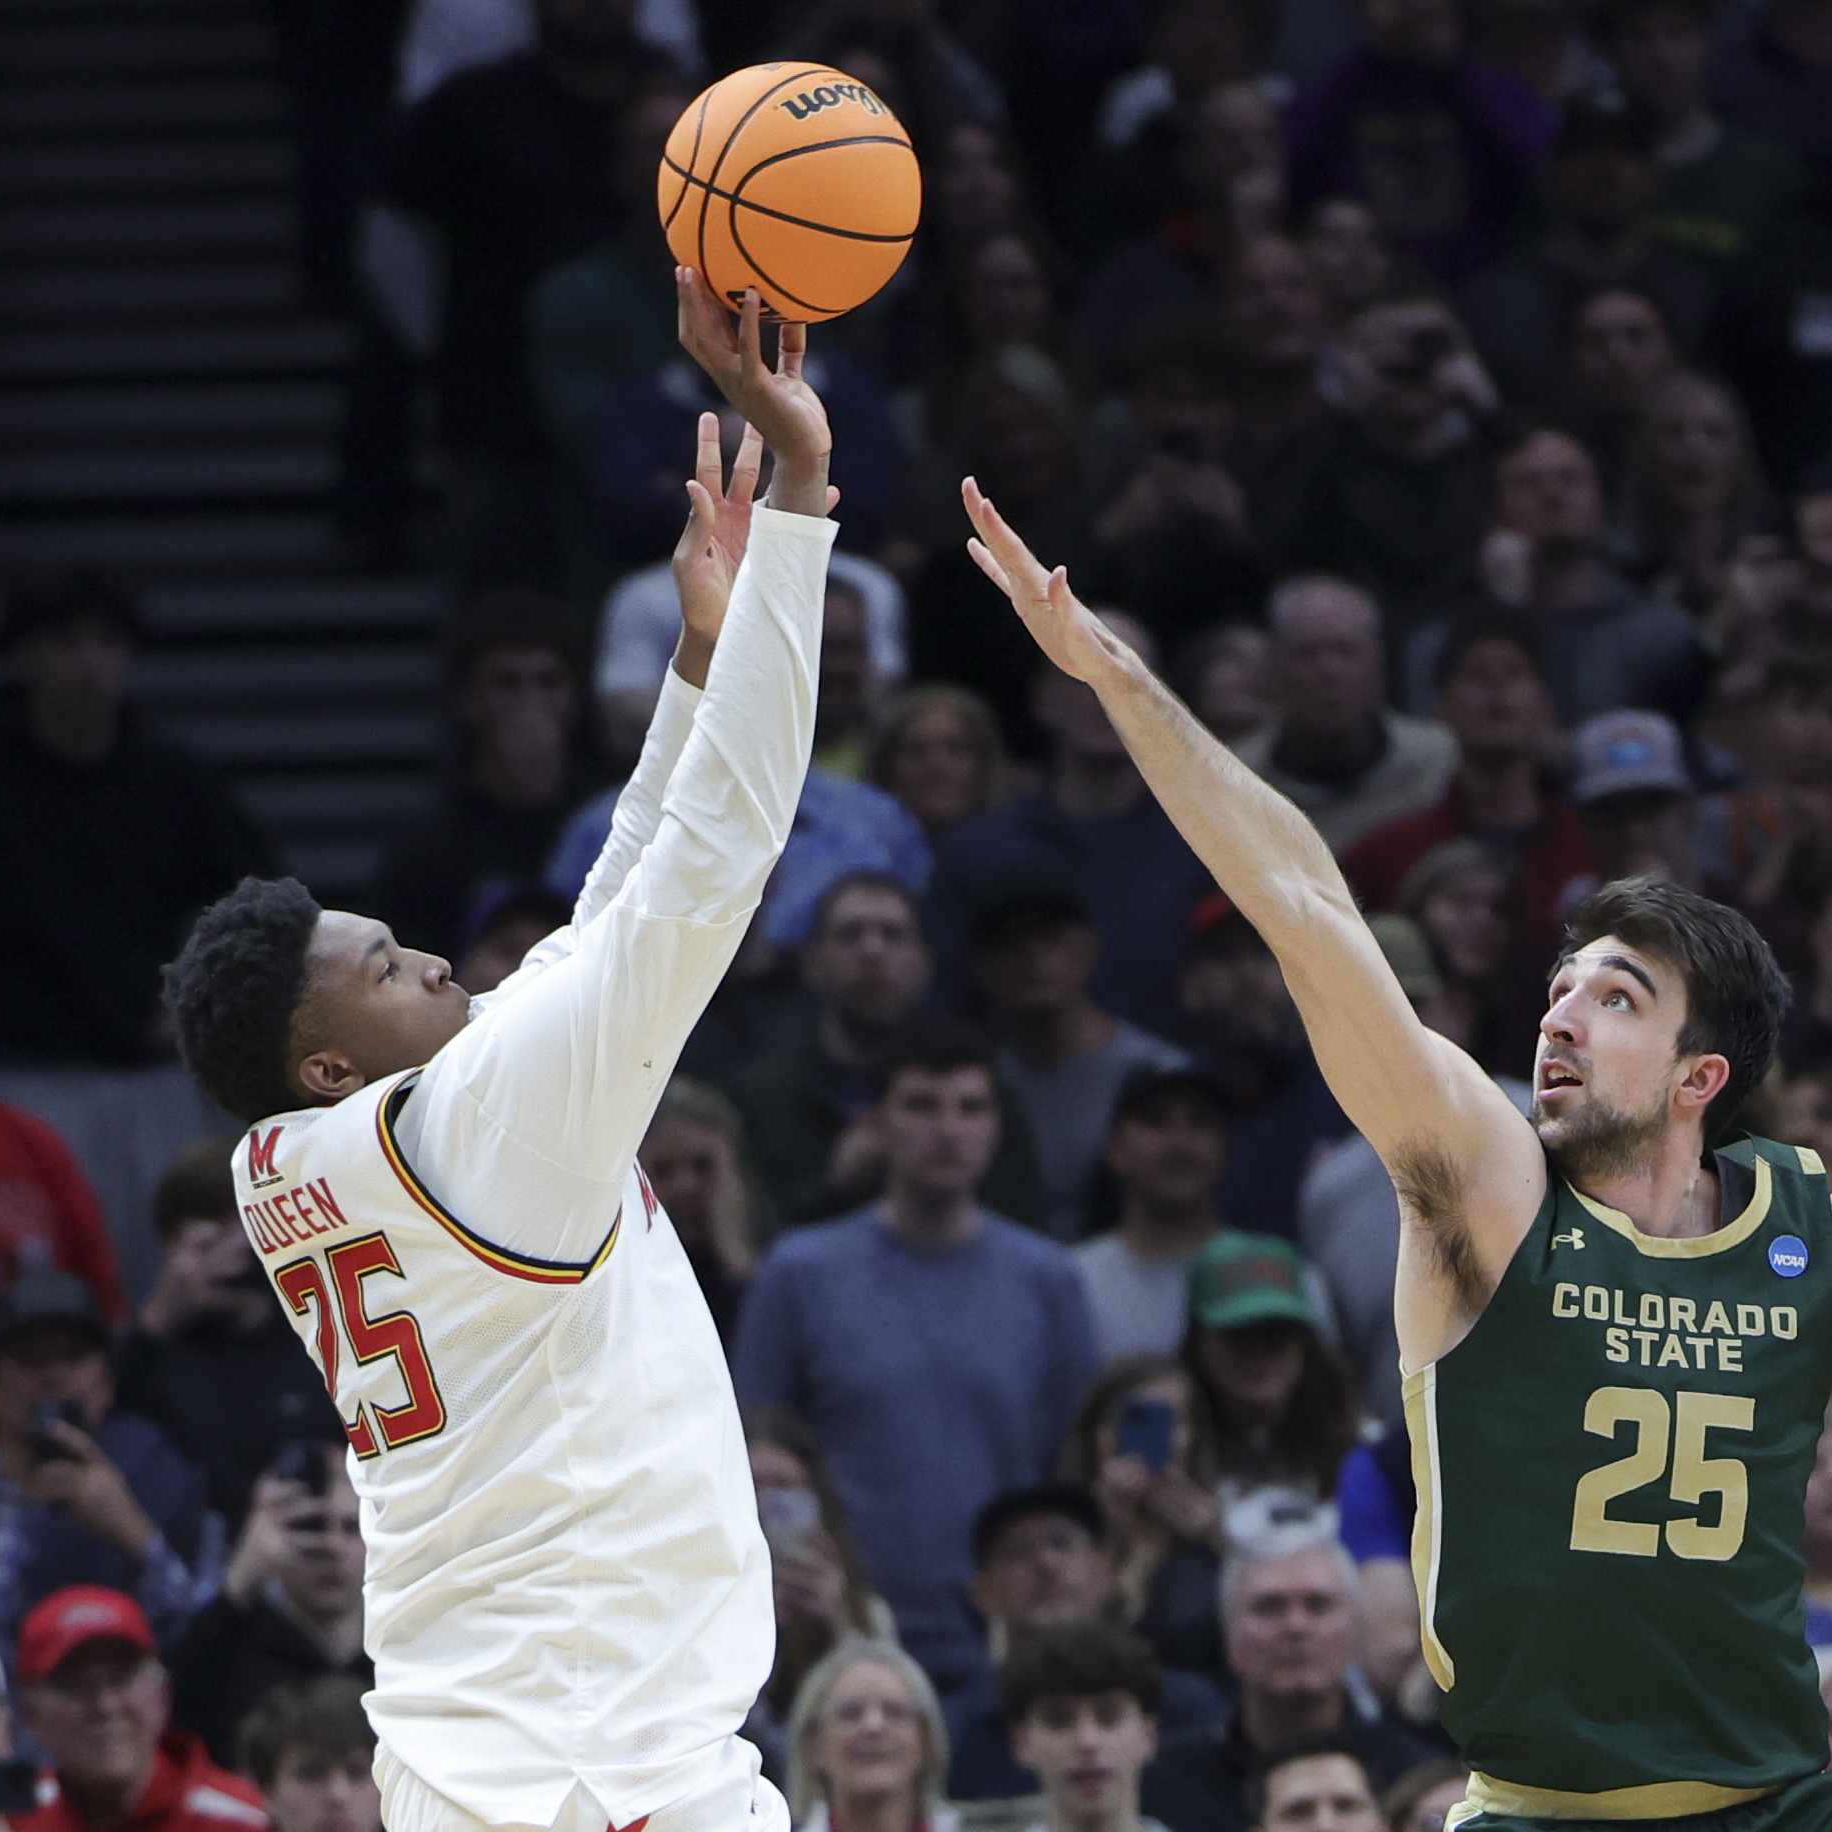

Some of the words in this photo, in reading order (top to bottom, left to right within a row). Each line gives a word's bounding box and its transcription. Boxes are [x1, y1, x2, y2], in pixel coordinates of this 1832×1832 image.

[244, 1177, 349, 1255] QUEEN
[1773, 1252, 1807, 1269] NCAA
[1552, 1282, 1798, 1340] COLORADO
[274, 1230, 447, 1461] 25
[1605, 1327, 1743, 1372] STATE
[1569, 1386, 1756, 1562] 25
